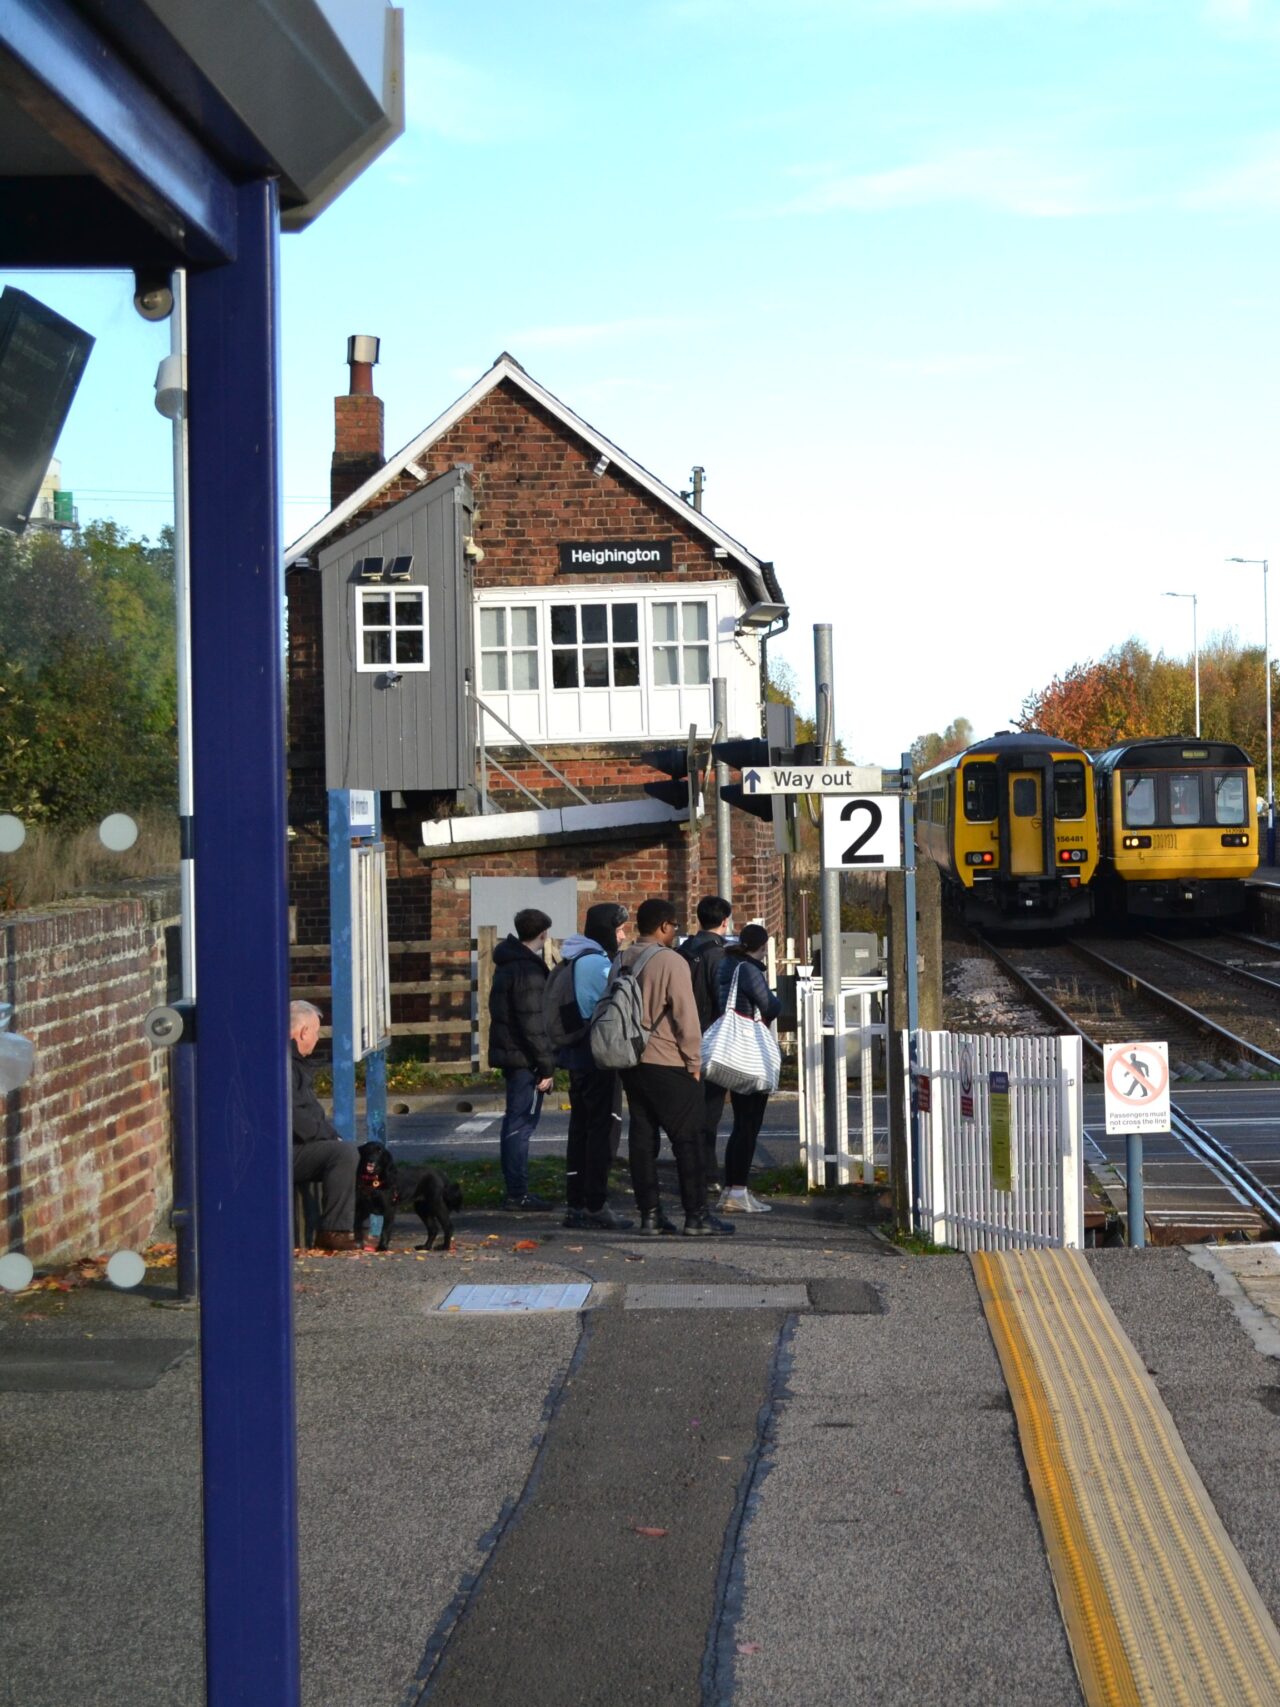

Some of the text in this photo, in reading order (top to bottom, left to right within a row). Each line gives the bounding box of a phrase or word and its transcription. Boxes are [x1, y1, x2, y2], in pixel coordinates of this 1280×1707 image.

[571, 548, 660, 565] Heighington
[773, 770, 852, 789] Way out
[840, 799, 884, 864] 2
[1057, 835, 1084, 843] 156481
